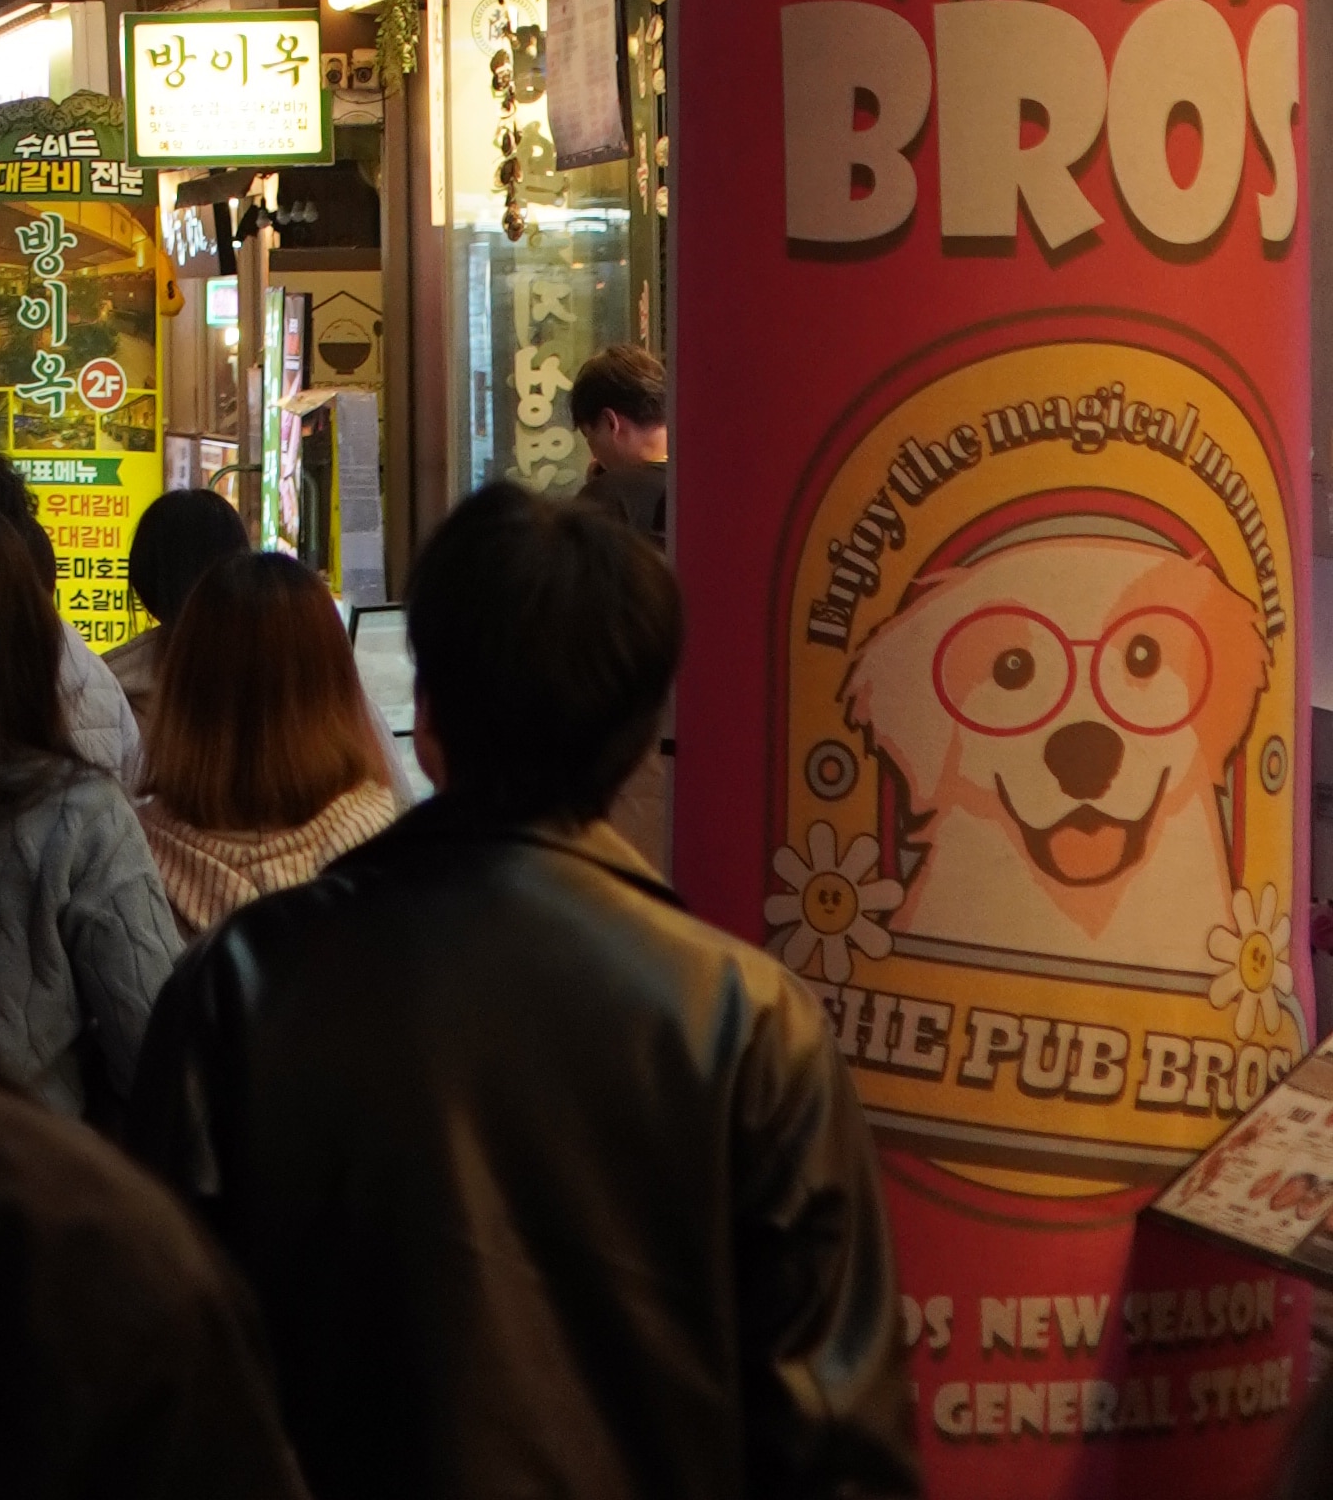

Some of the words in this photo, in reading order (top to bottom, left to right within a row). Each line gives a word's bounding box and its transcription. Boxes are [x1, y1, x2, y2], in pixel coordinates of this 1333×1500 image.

[145, 33, 311, 89] 방이옥
[14, 129, 103, 159] 수비드
[15, 211, 78, 419] 방이옥
[85, 372, 121, 399] 2F
[46, 494, 131, 518] 우대갈비
[807, 482, 911, 651] Enjoy
[985, 380, 1200, 470] magical
[961, 1007, 1132, 1098] PUB
[979, 1291, 1113, 1352] NEW
[933, 1378, 1178, 1445] GENERAL
